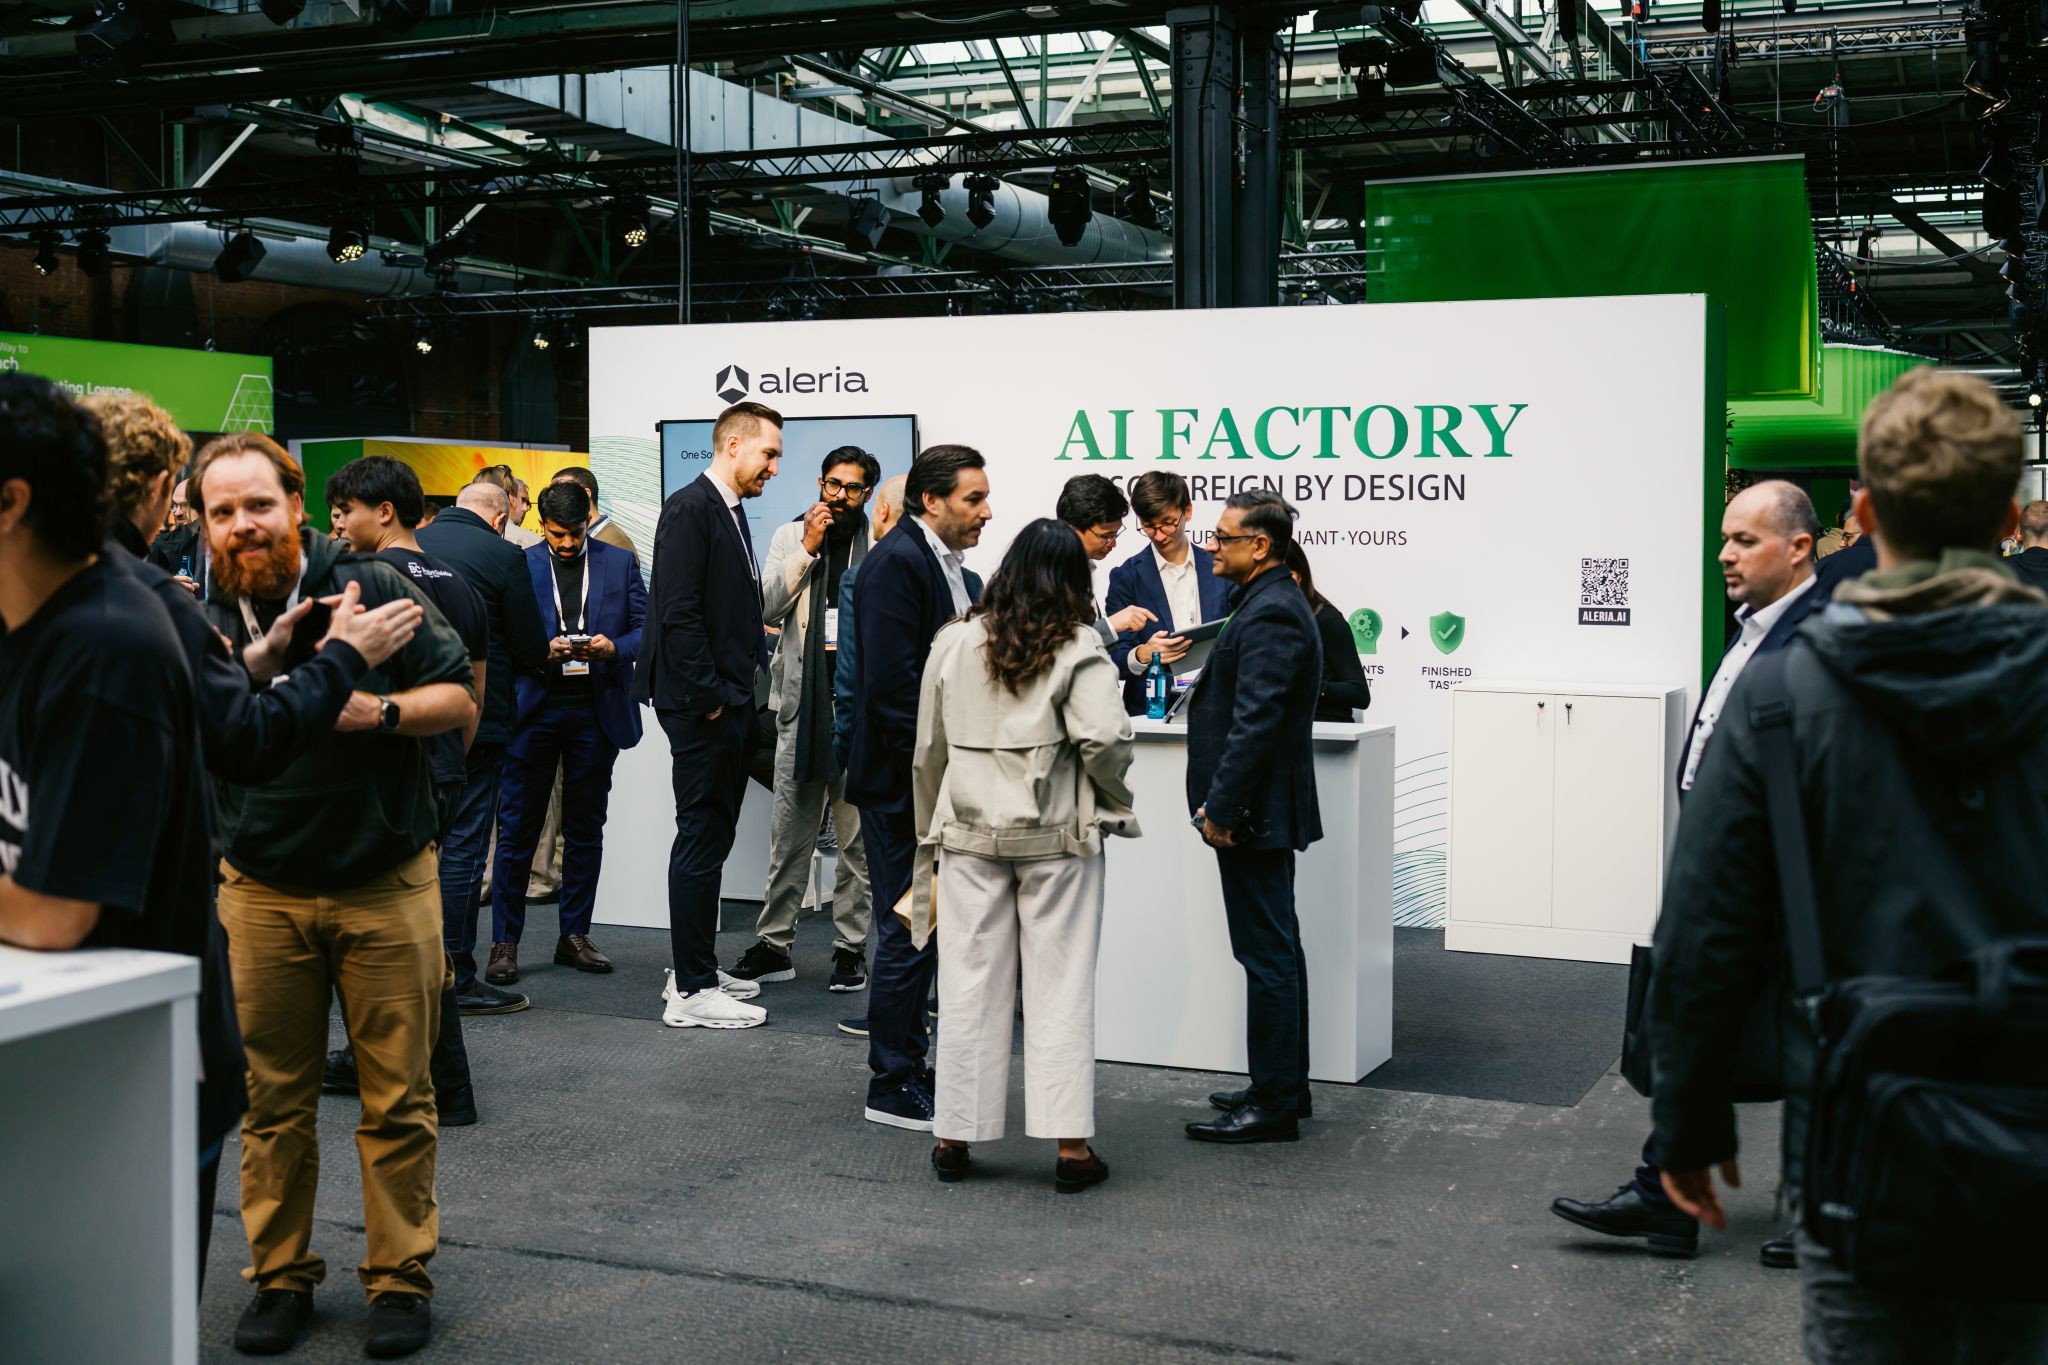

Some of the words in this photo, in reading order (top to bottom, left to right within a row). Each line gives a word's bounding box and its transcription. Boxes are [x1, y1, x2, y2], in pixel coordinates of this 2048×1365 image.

[759, 366, 869, 394] aleria
[1053, 409, 1134, 460] AI
[1155, 403, 1528, 461] FACTORY
[681, 450, 699, 460] One
[1295, 474, 1333, 501] BY
[1344, 473, 1465, 501] DESIGN
[1348, 530, 1407, 546] YOURS
[1582, 610, 1627, 622] ALERIA.AI
[1421, 666, 1472, 677] FINISHED
[1429, 680, 1462, 690] TAS
